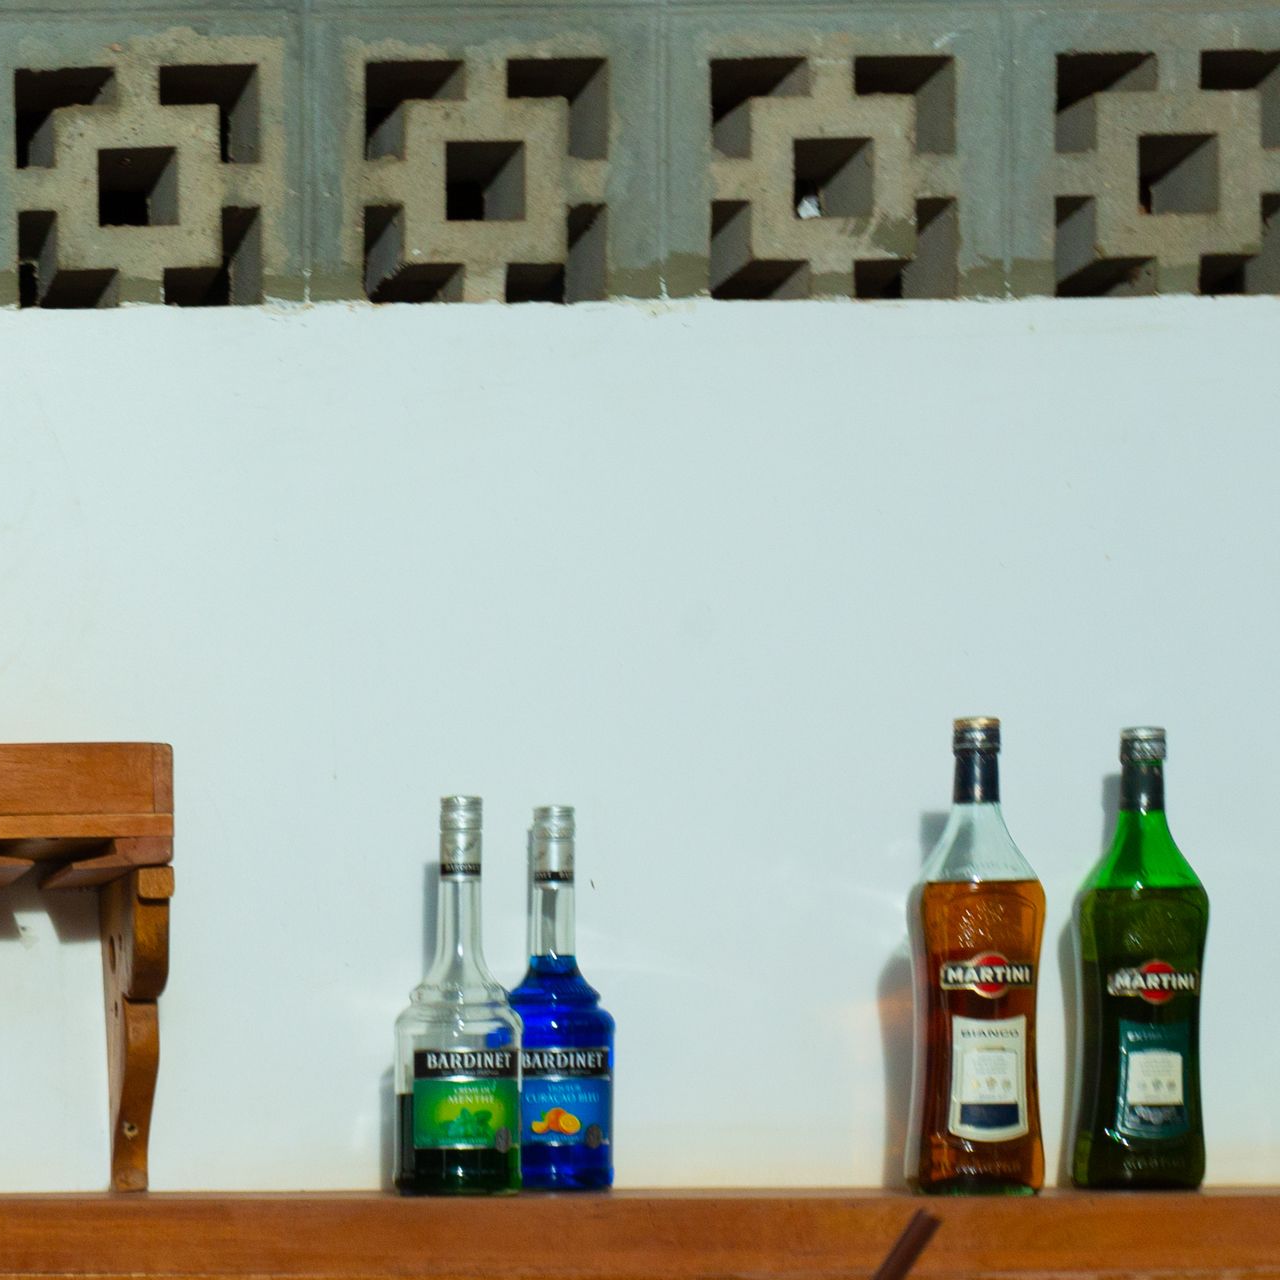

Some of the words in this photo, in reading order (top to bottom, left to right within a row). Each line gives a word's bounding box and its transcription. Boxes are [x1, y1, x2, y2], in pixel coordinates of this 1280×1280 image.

[947, 965, 1030, 984] MARTINI
[1114, 971, 1195, 991] MARTINI
[426, 1052, 512, 1070] BARDINET
[522, 1051, 604, 1069] BARDINET
